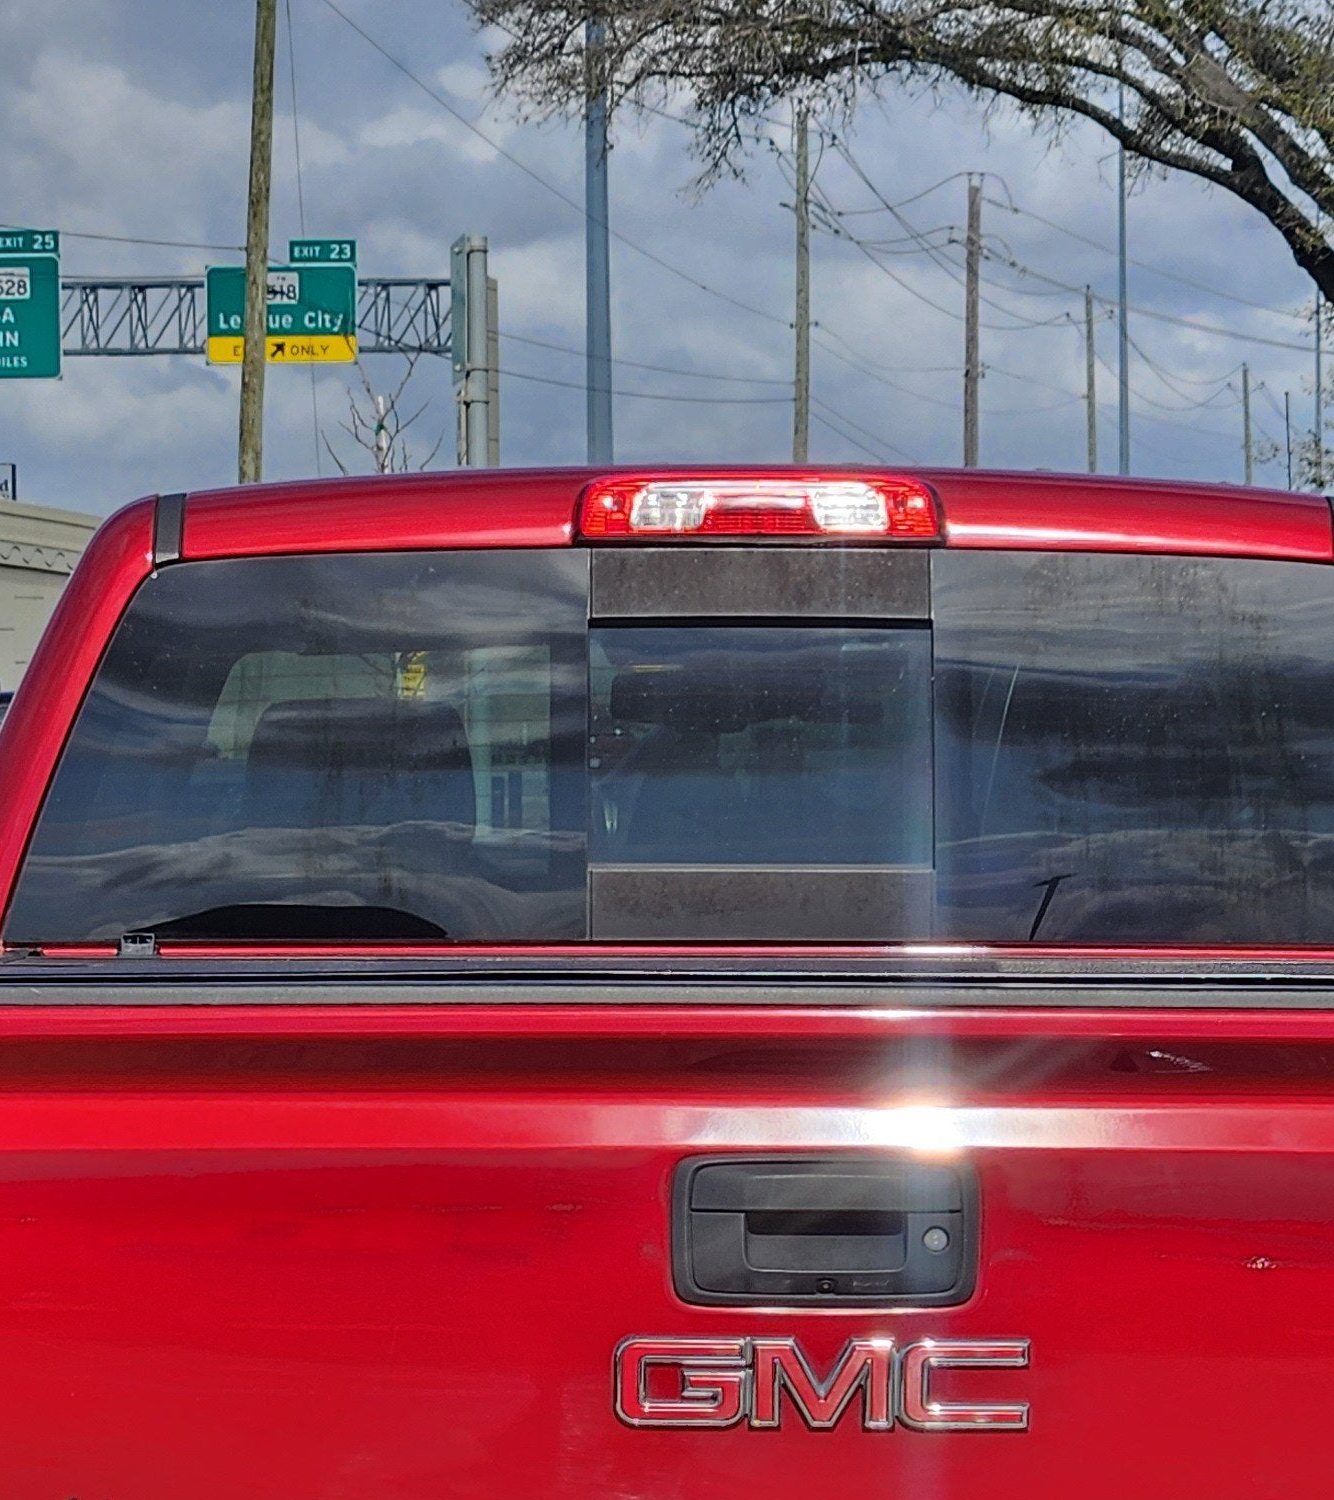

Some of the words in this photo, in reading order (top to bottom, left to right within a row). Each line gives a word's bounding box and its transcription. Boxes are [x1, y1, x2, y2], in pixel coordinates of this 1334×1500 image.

[32, 234, 55, 250] 25
[293, 246, 320, 259] EXIT
[329, 244, 351, 260] 23
[218, 311, 293, 330] Leue
[304, 310, 344, 332] City
[290, 344, 330, 357] ONLY
[613, 1336, 1031, 1431] GMC
